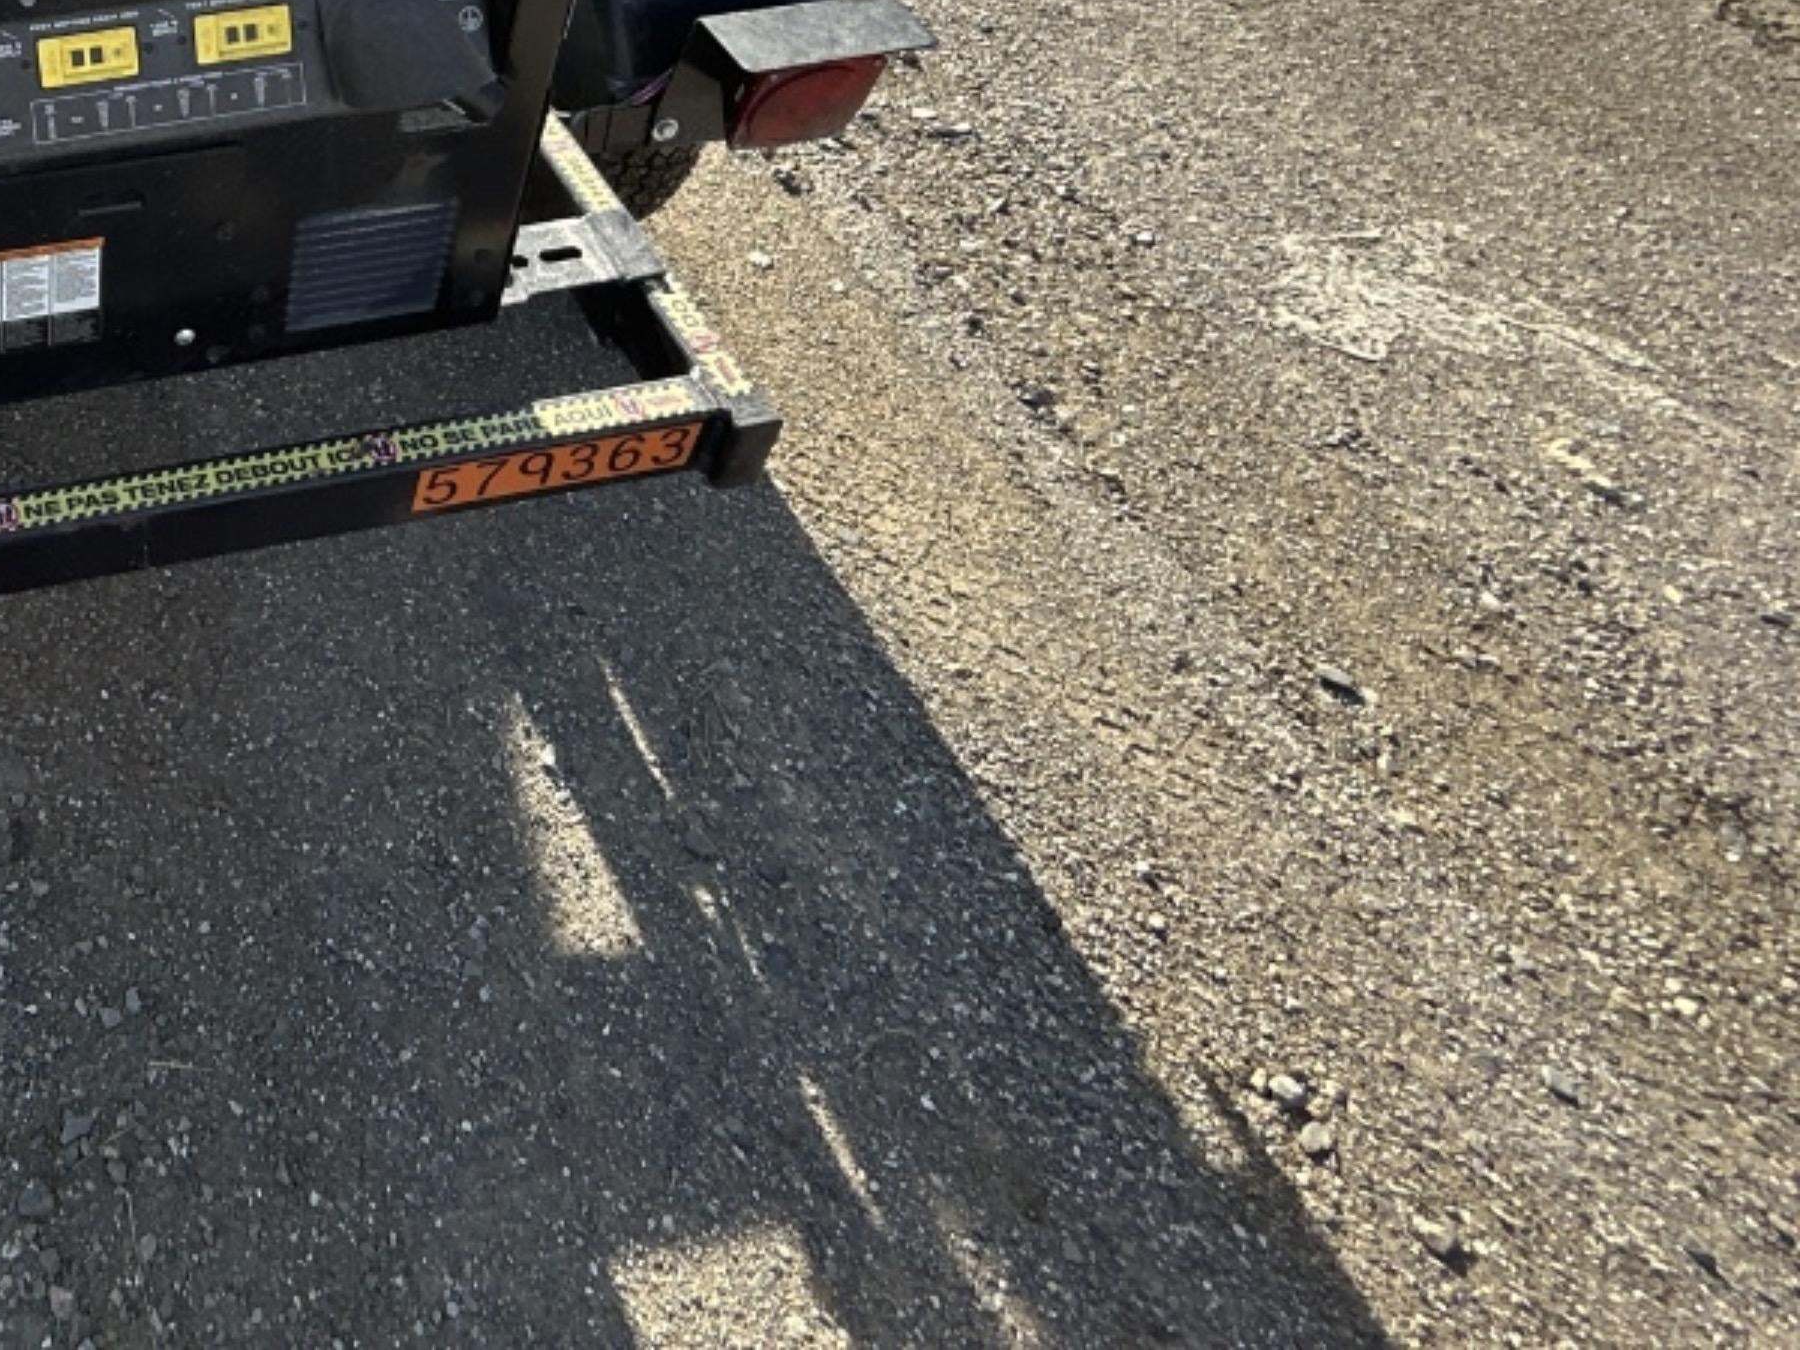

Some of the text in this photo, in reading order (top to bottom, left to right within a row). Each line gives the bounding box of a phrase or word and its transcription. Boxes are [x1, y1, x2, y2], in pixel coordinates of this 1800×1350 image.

[400, 434, 439, 452] NO
[444, 427, 478, 445] SE
[553, 404, 613, 427] AQUI
[23, 502, 62, 520] NE
[66, 492, 119, 512] PAS
[125, 474, 211, 502] TENEZ
[216, 454, 322, 486] DEBOUT
[421, 426, 692, 506] 579363
